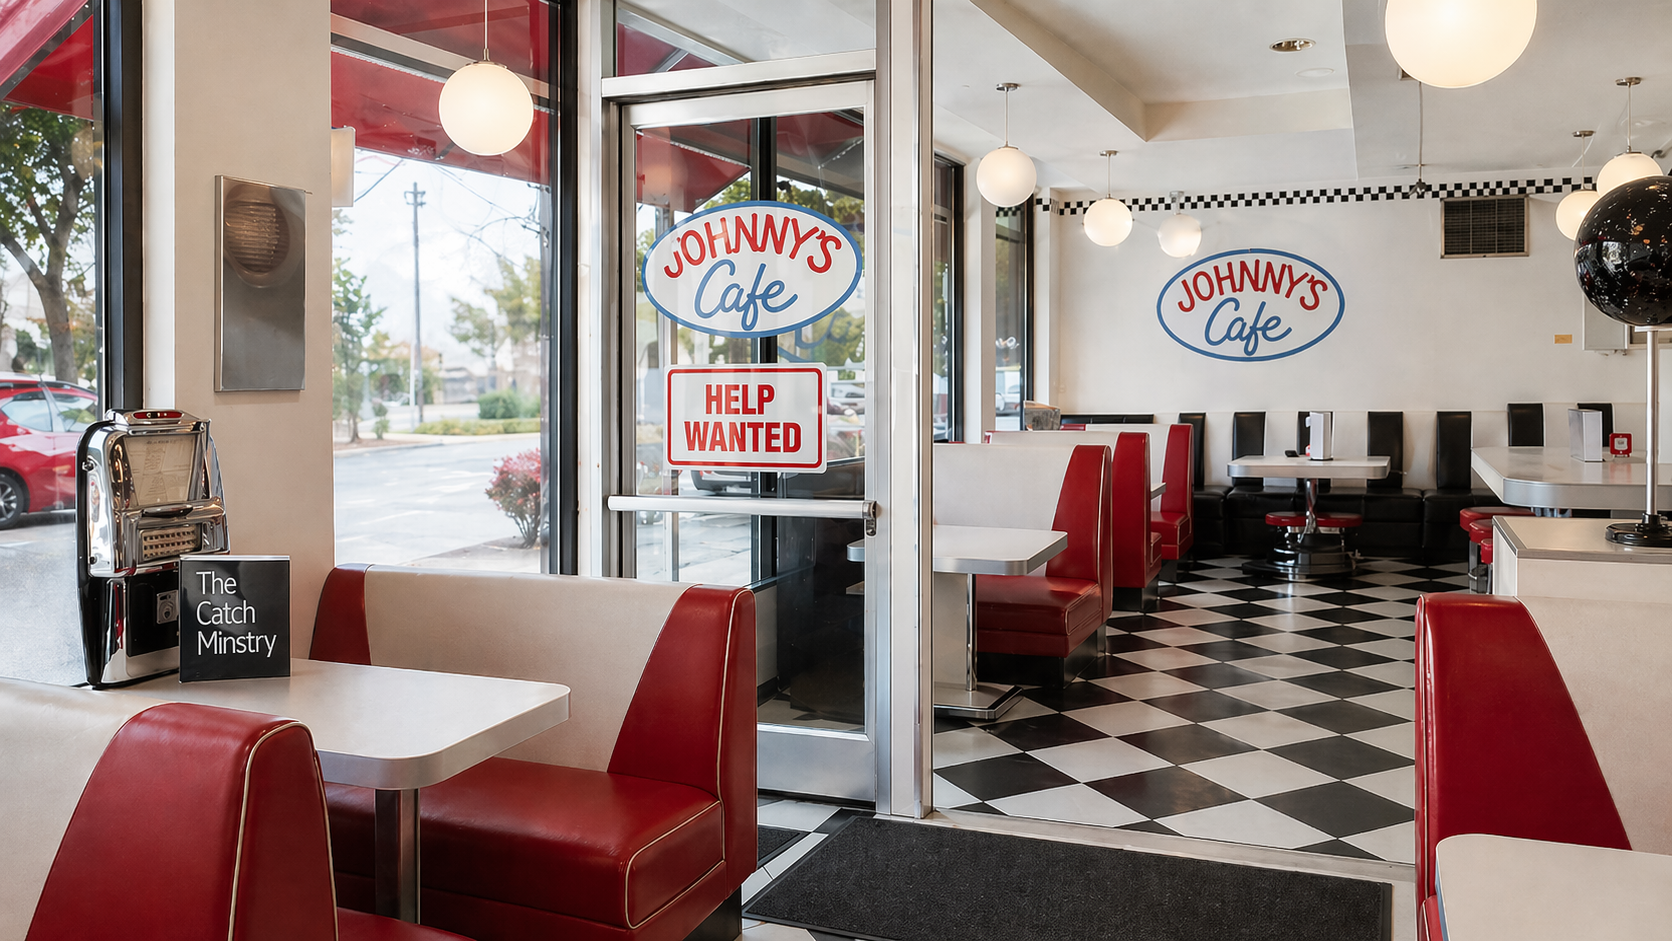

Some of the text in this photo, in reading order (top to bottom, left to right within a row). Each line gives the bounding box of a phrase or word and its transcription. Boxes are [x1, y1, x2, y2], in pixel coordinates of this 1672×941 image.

[664, 213, 842, 278] JOHNNY'S
[694, 259, 798, 331] Cafe
[1178, 259, 1328, 312] JOHNNY'S
[1204, 297, 1292, 356] Cafe
[705, 384, 775, 415] HELP
[684, 421, 801, 452] WANTED
[196, 571, 237, 594] The
[197, 600, 255, 625] Catch
[198, 631, 277, 657] Minstry
